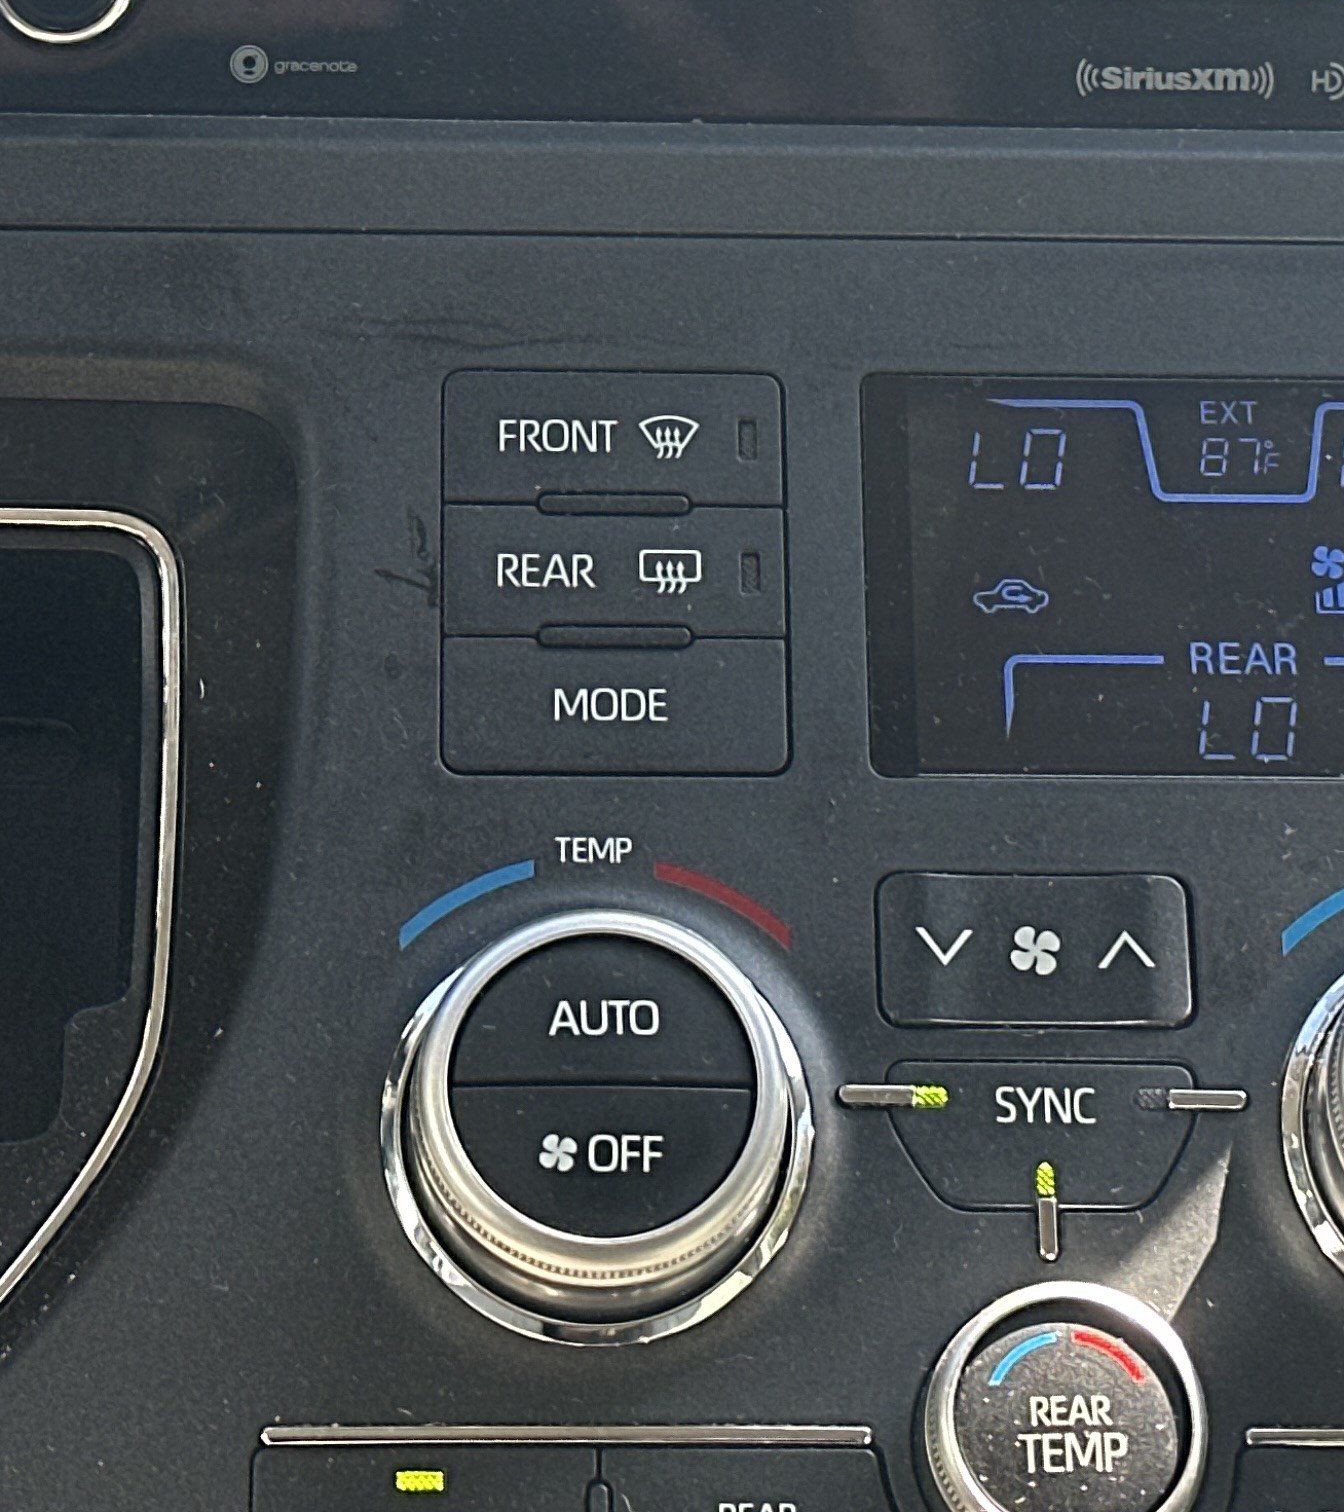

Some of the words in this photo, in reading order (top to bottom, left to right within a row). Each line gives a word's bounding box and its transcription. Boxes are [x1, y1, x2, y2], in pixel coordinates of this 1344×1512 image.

[1200, 400, 1258, 426] EXT
[497, 418, 619, 453] FRONT
[496, 553, 597, 589] REAR
[1190, 643, 1298, 677] REAR
[553, 687, 669, 722] MODE
[555, 836, 634, 864] TEMP
[549, 999, 660, 1036] AUTO
[994, 1085, 1097, 1125] SYNC
[587, 1134, 665, 1173] OFF
[1029, 1395, 1113, 1428] REAR
[1016, 1432, 1129, 1474] TEMP
